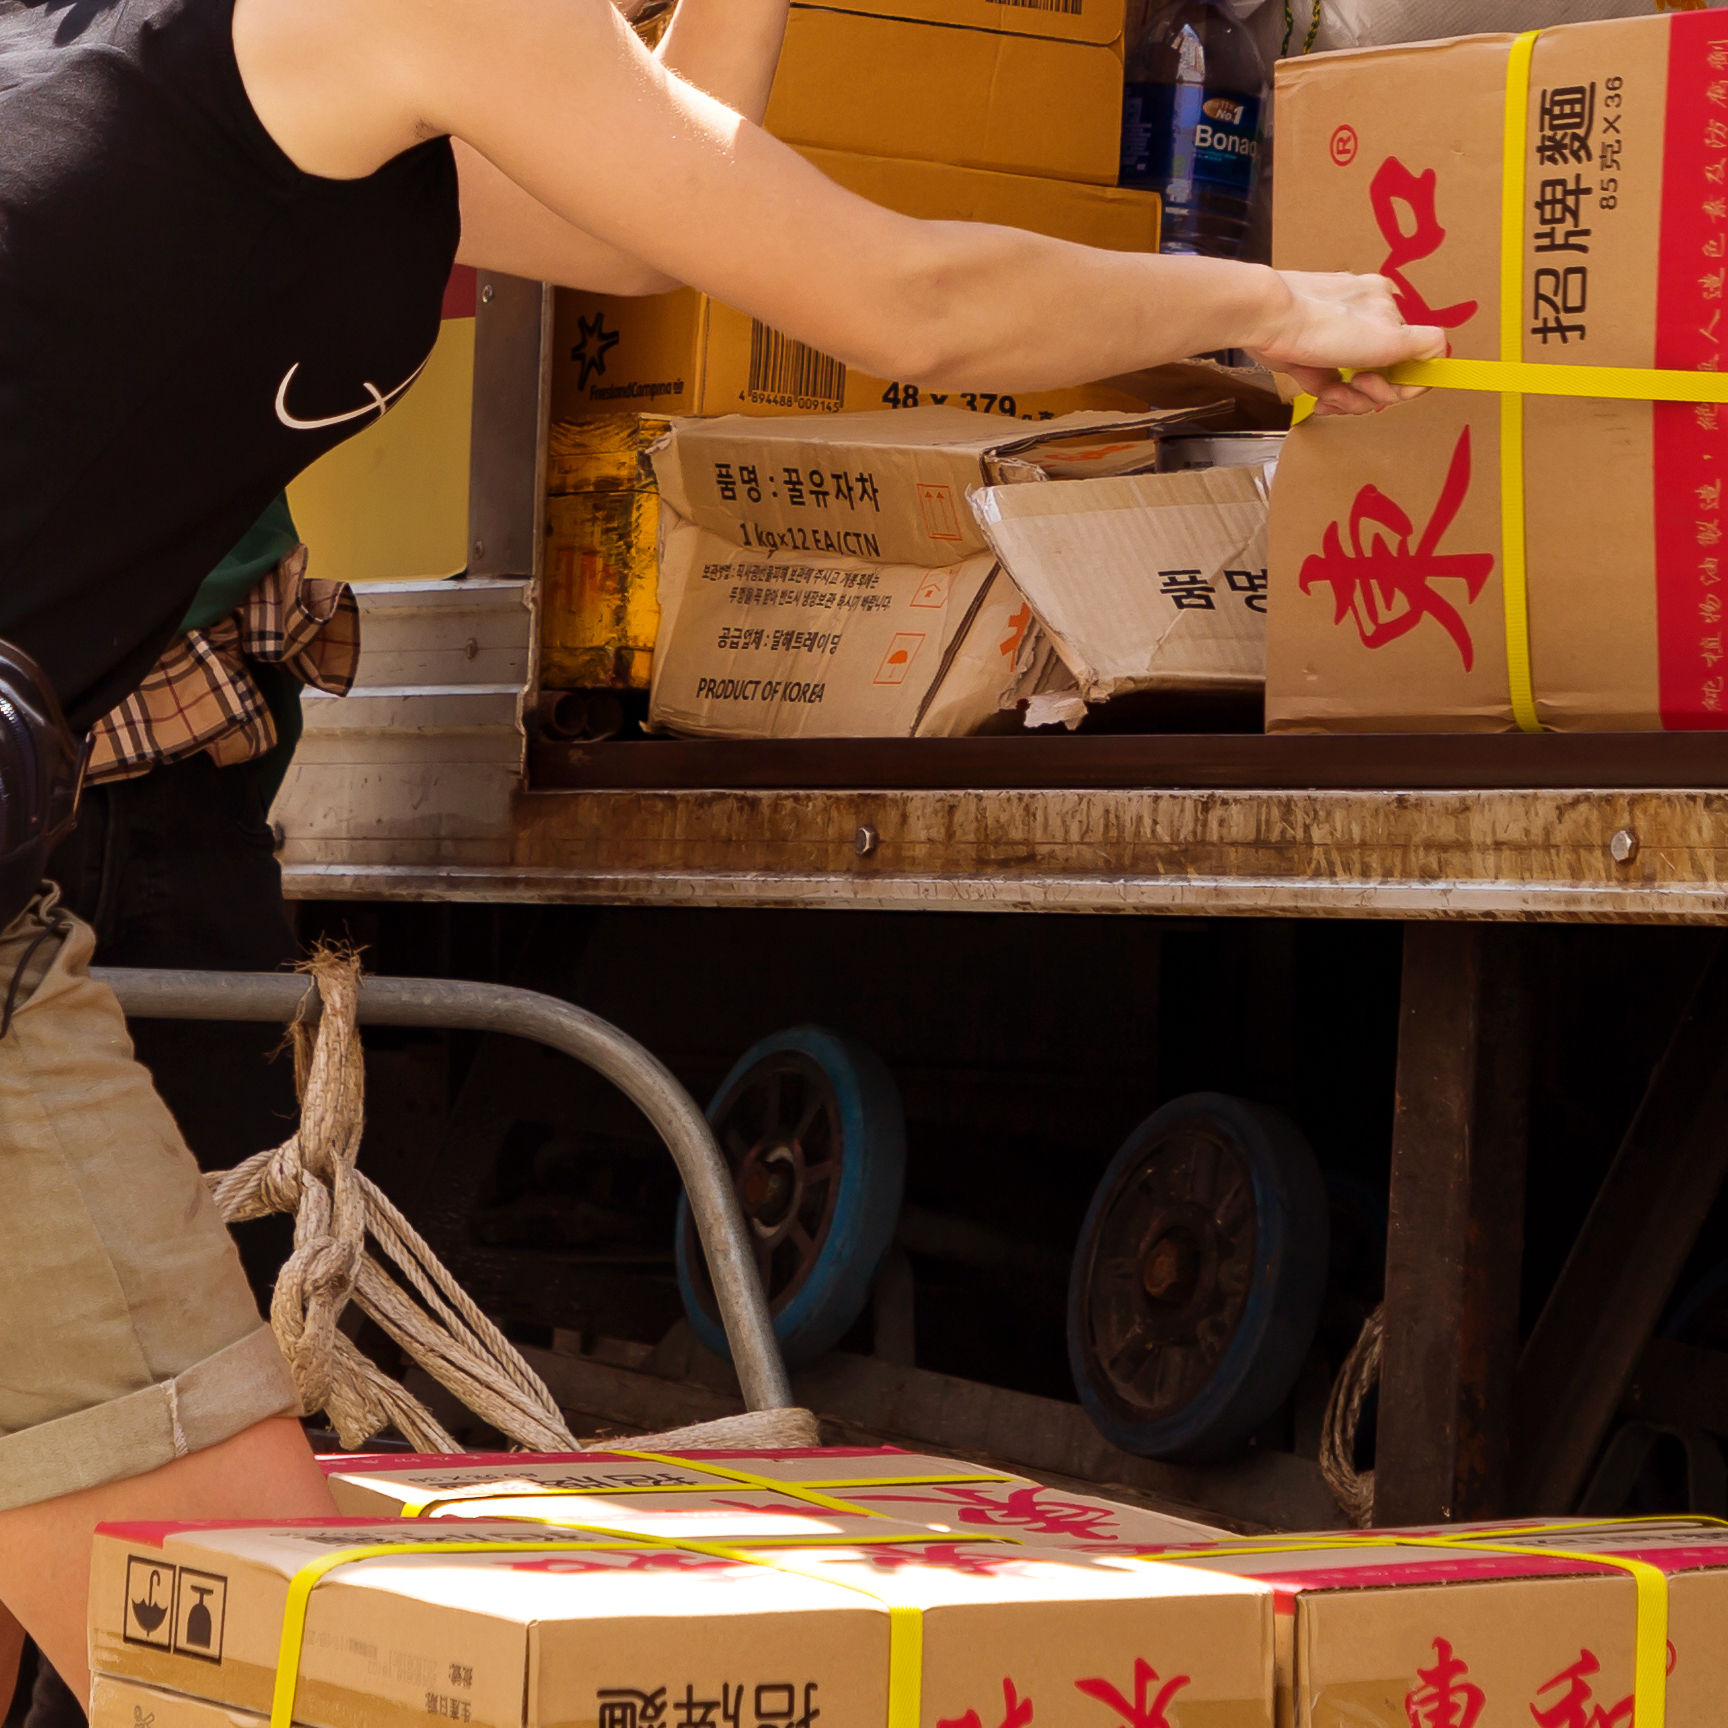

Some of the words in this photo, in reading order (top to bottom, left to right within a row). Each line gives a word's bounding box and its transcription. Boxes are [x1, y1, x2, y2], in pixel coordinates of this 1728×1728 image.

[1531, 79, 1598, 345] 招牌麵
[738, 392, 746, 403] 4
[750, 390, 794, 408] 894488
[797, 396, 841, 414] 009145
[881, 381, 919, 410] 48
[715, 463, 762, 503] 품명
[782, 467, 881, 513] 꿀유자차
[696, 677, 762, 701] PRODUCT
[761, 680, 782, 702] OF
[781, 681, 826, 704] KOREA
